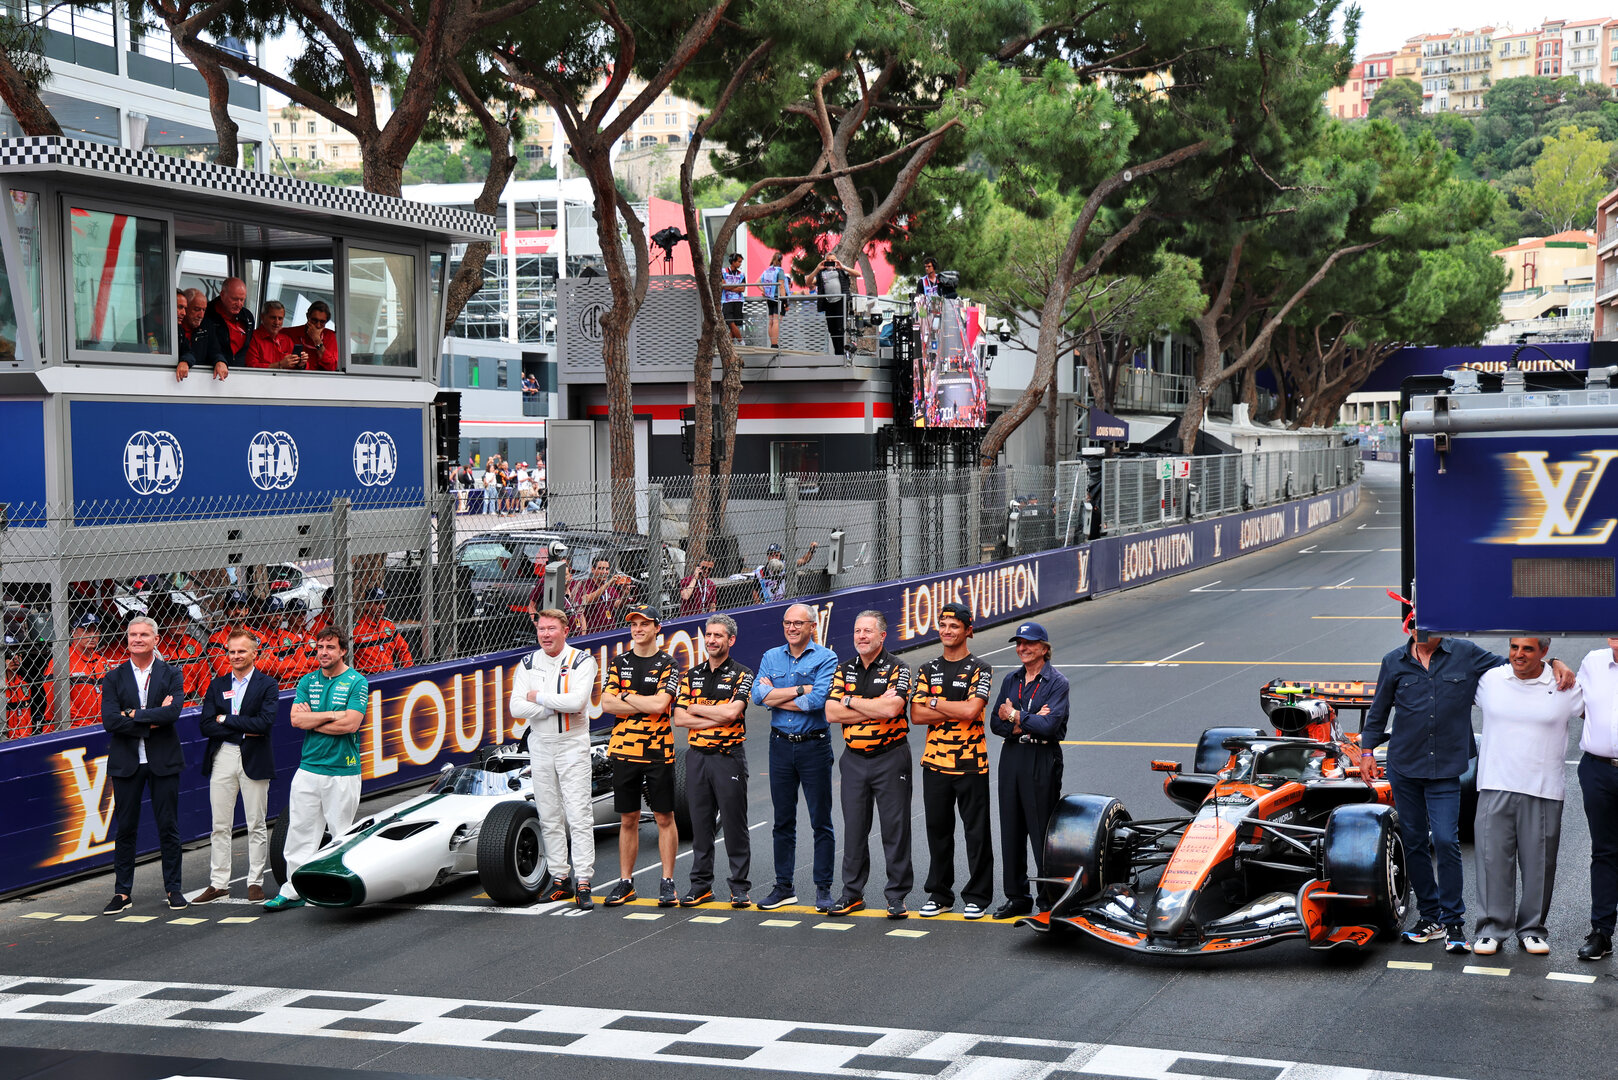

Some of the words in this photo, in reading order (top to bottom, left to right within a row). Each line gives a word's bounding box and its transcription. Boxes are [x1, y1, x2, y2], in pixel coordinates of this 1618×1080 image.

[1464, 361, 1508, 373] LOUIS
[1515, 449, 1618, 545] LV
[1241, 517, 1260, 550] LOUIS
[1261, 511, 1285, 543] VUITTON
[1075, 550, 1091, 593] LV
[1123, 540, 1154, 582] LOUIS
[1155, 531, 1194, 572] VUITTON
[968, 560, 1039, 622] VUITTON
[345, 756, 357, 766] 14
